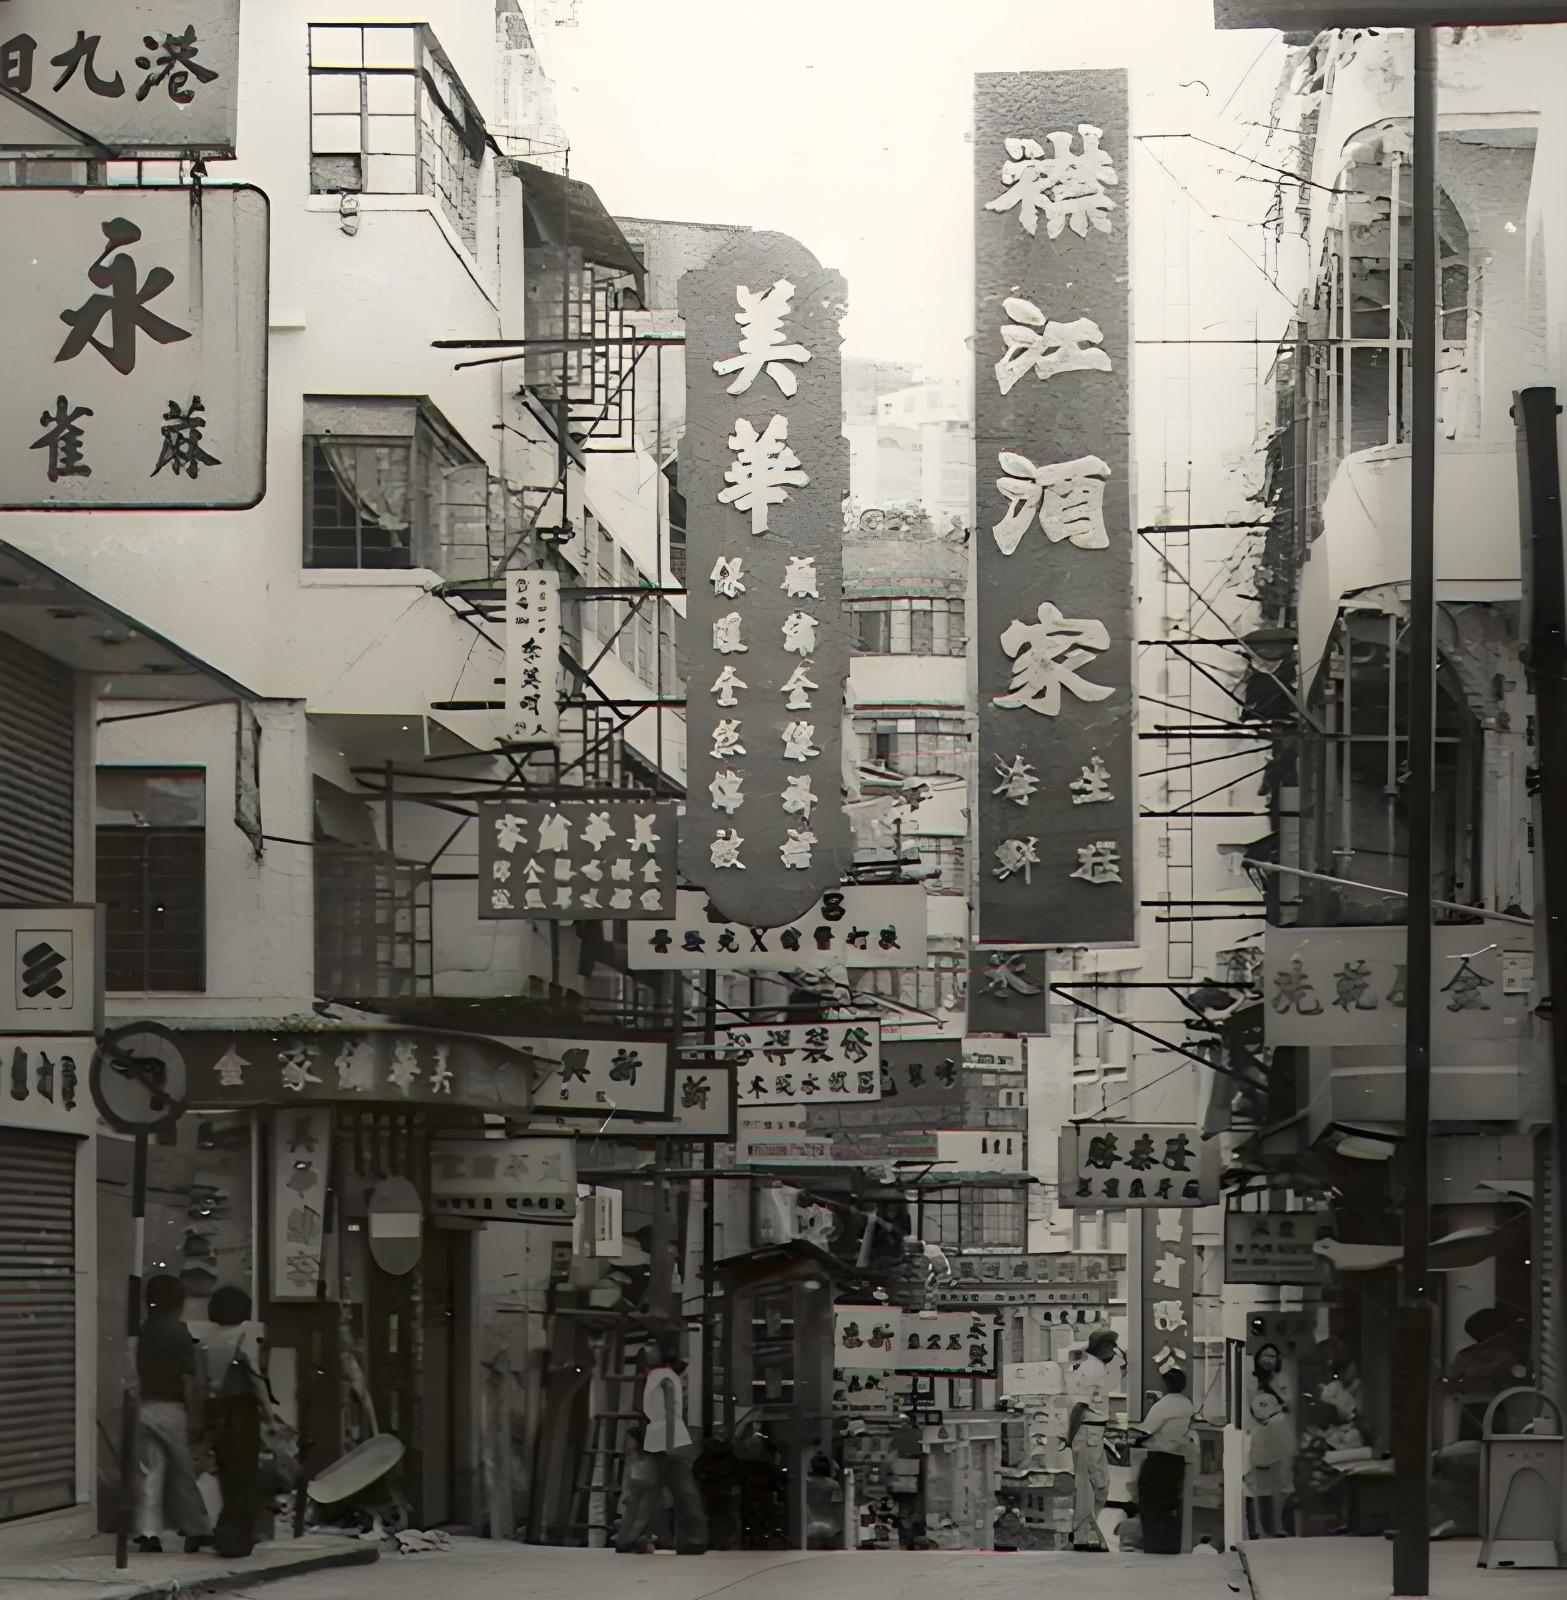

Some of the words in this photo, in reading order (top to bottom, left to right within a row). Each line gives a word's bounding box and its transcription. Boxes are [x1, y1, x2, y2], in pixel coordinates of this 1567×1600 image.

[54, 217, 192, 375] 永
[983, 123, 1118, 716] 襟江酒家
